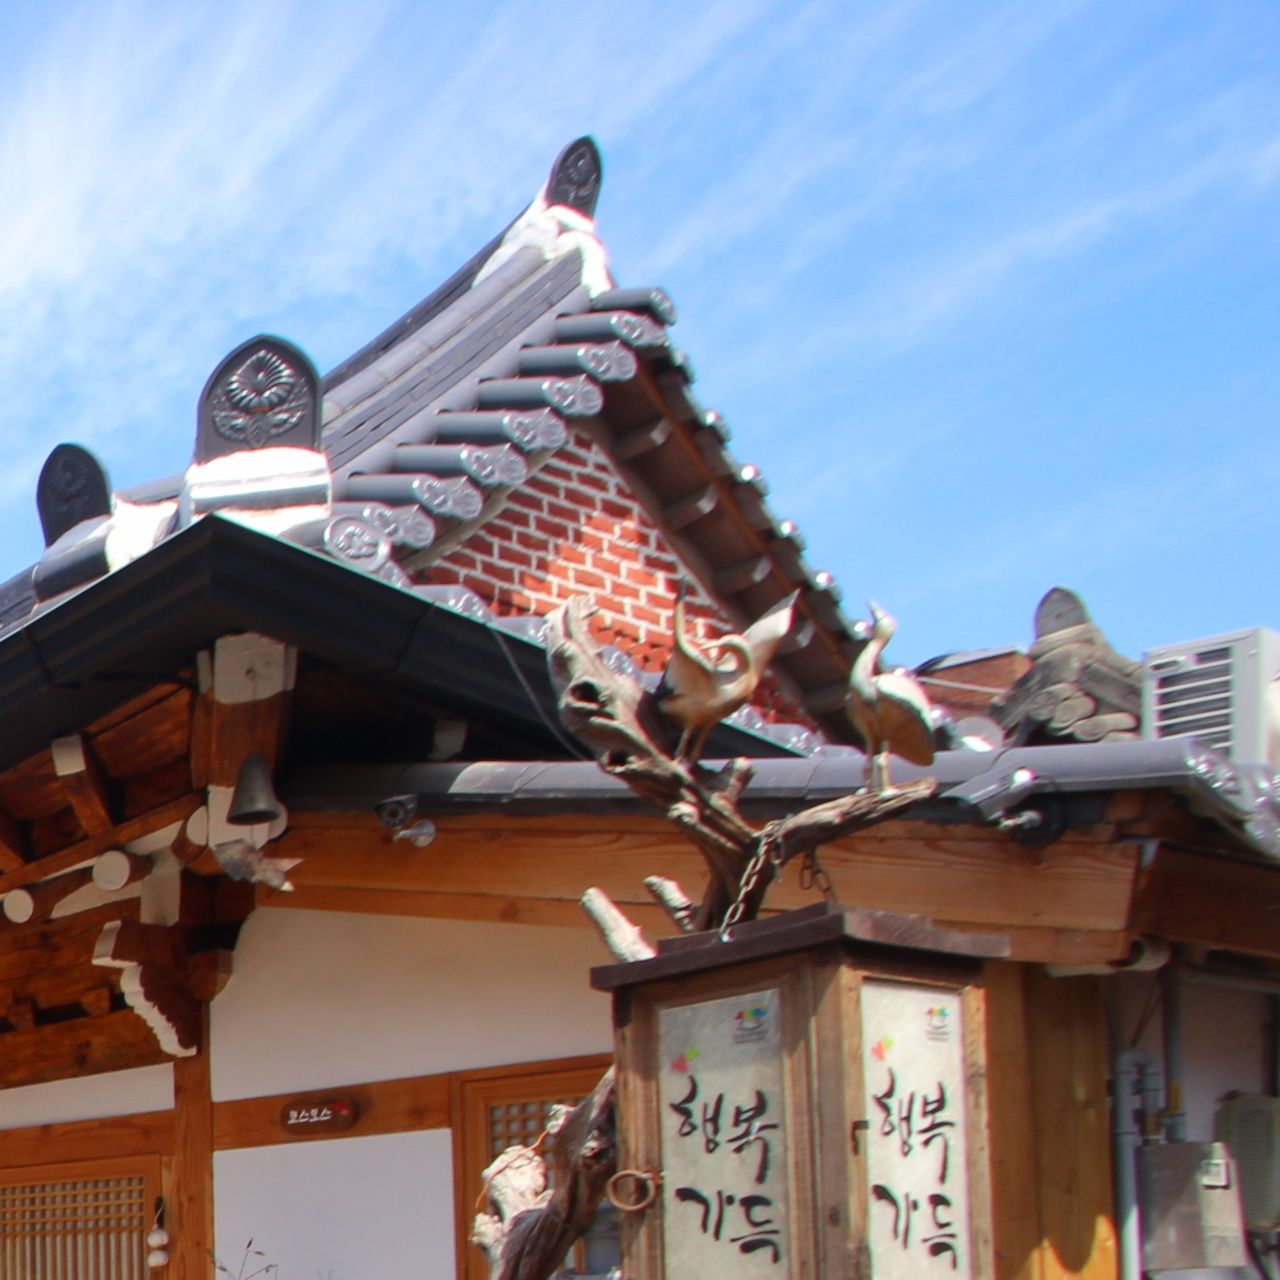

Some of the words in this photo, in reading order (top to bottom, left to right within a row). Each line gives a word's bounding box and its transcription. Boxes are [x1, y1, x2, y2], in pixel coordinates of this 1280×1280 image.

[287, 1108, 333, 1124] 코스모스
[669, 1074, 778, 1184] 행복
[872, 1068, 957, 1184] 행복
[675, 1187, 782, 1265] 가득
[872, 1184, 959, 1270] 가득
